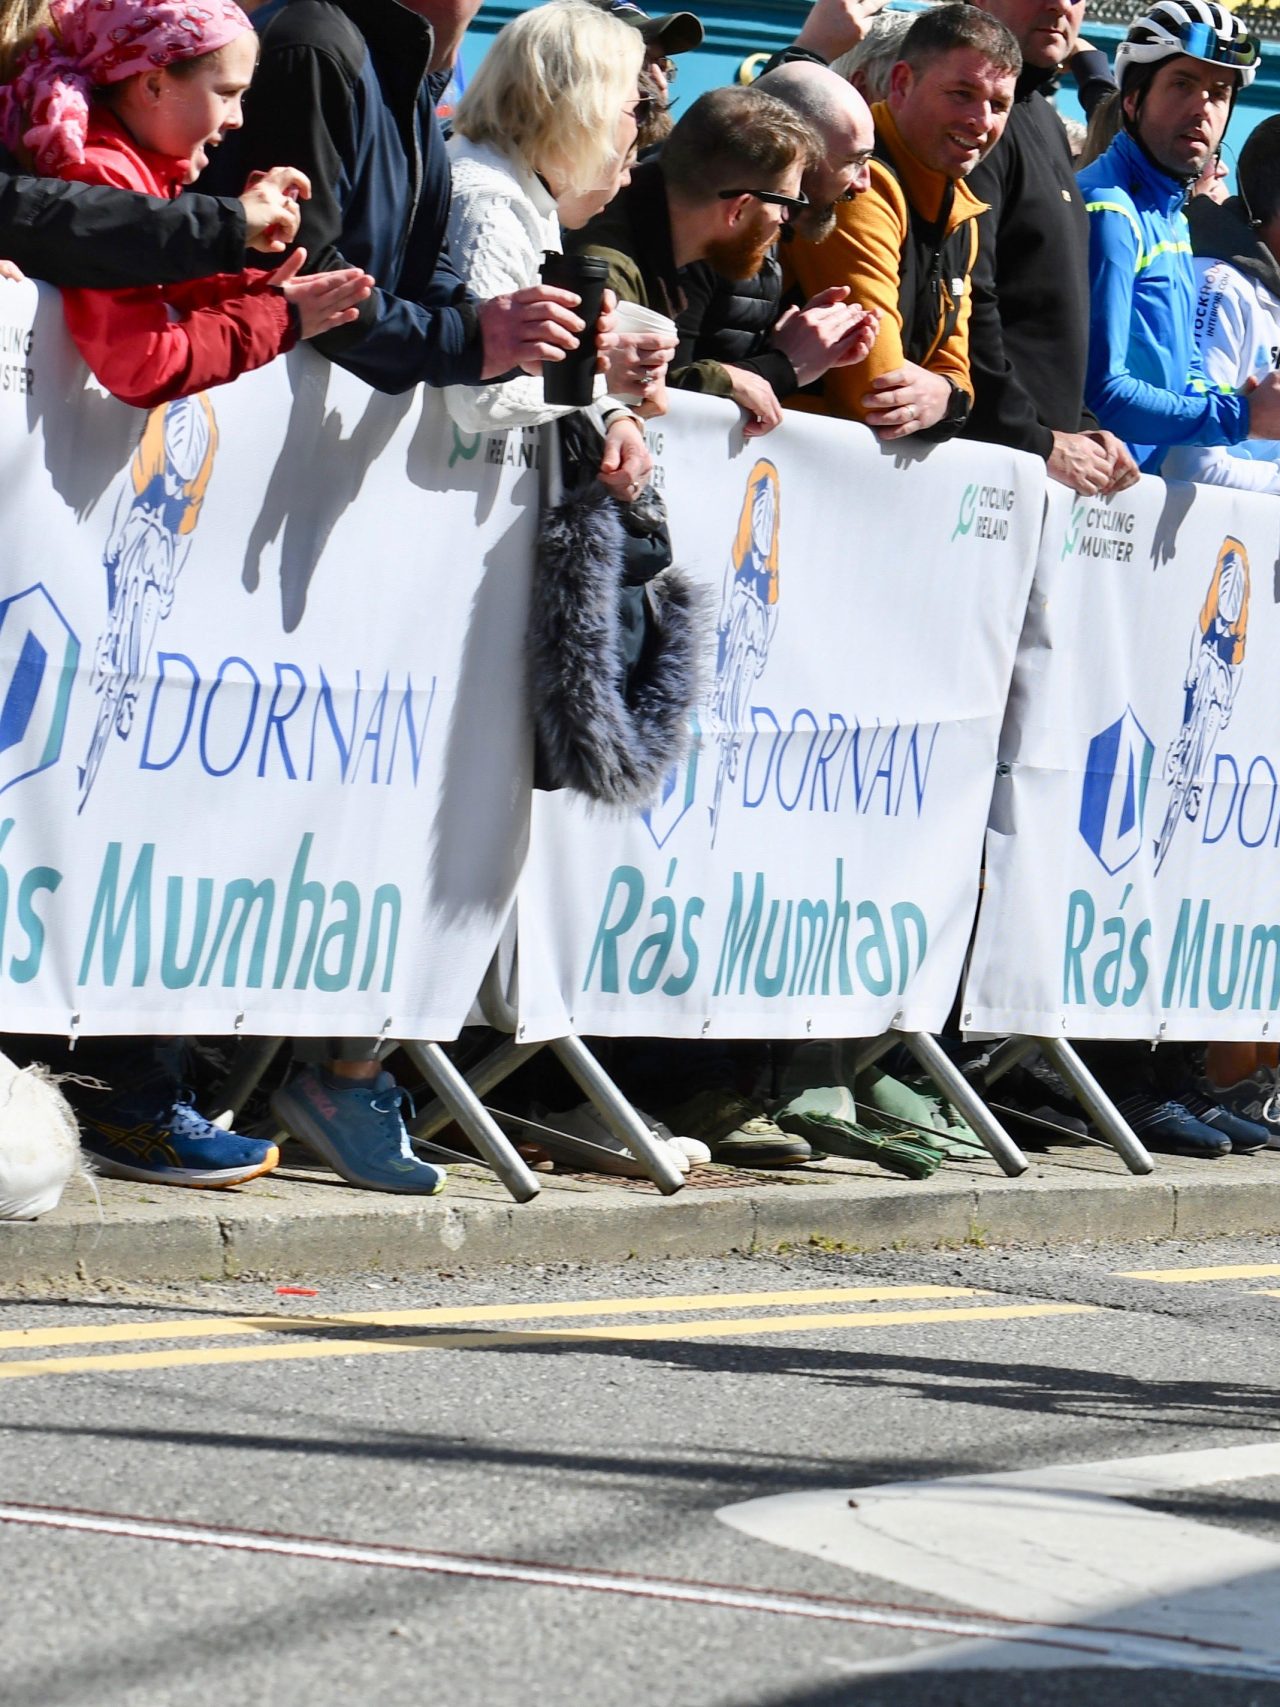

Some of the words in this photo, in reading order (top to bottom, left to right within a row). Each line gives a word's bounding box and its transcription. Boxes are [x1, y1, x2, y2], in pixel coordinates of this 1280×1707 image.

[975, 516, 1009, 541] IRELAND
[979, 486, 1015, 511] CYCLING
[1078, 535, 1134, 562] MUNSTER
[1086, 508, 1136, 534] CYCLING
[139, 651, 437, 788] DORNAN
[743, 706, 942, 819] DORNAN
[78, 832, 402, 994] Mumhan
[583, 857, 704, 997] Rás
[712, 857, 929, 998] Mumhan
[1062, 883, 1153, 1009] Rás
